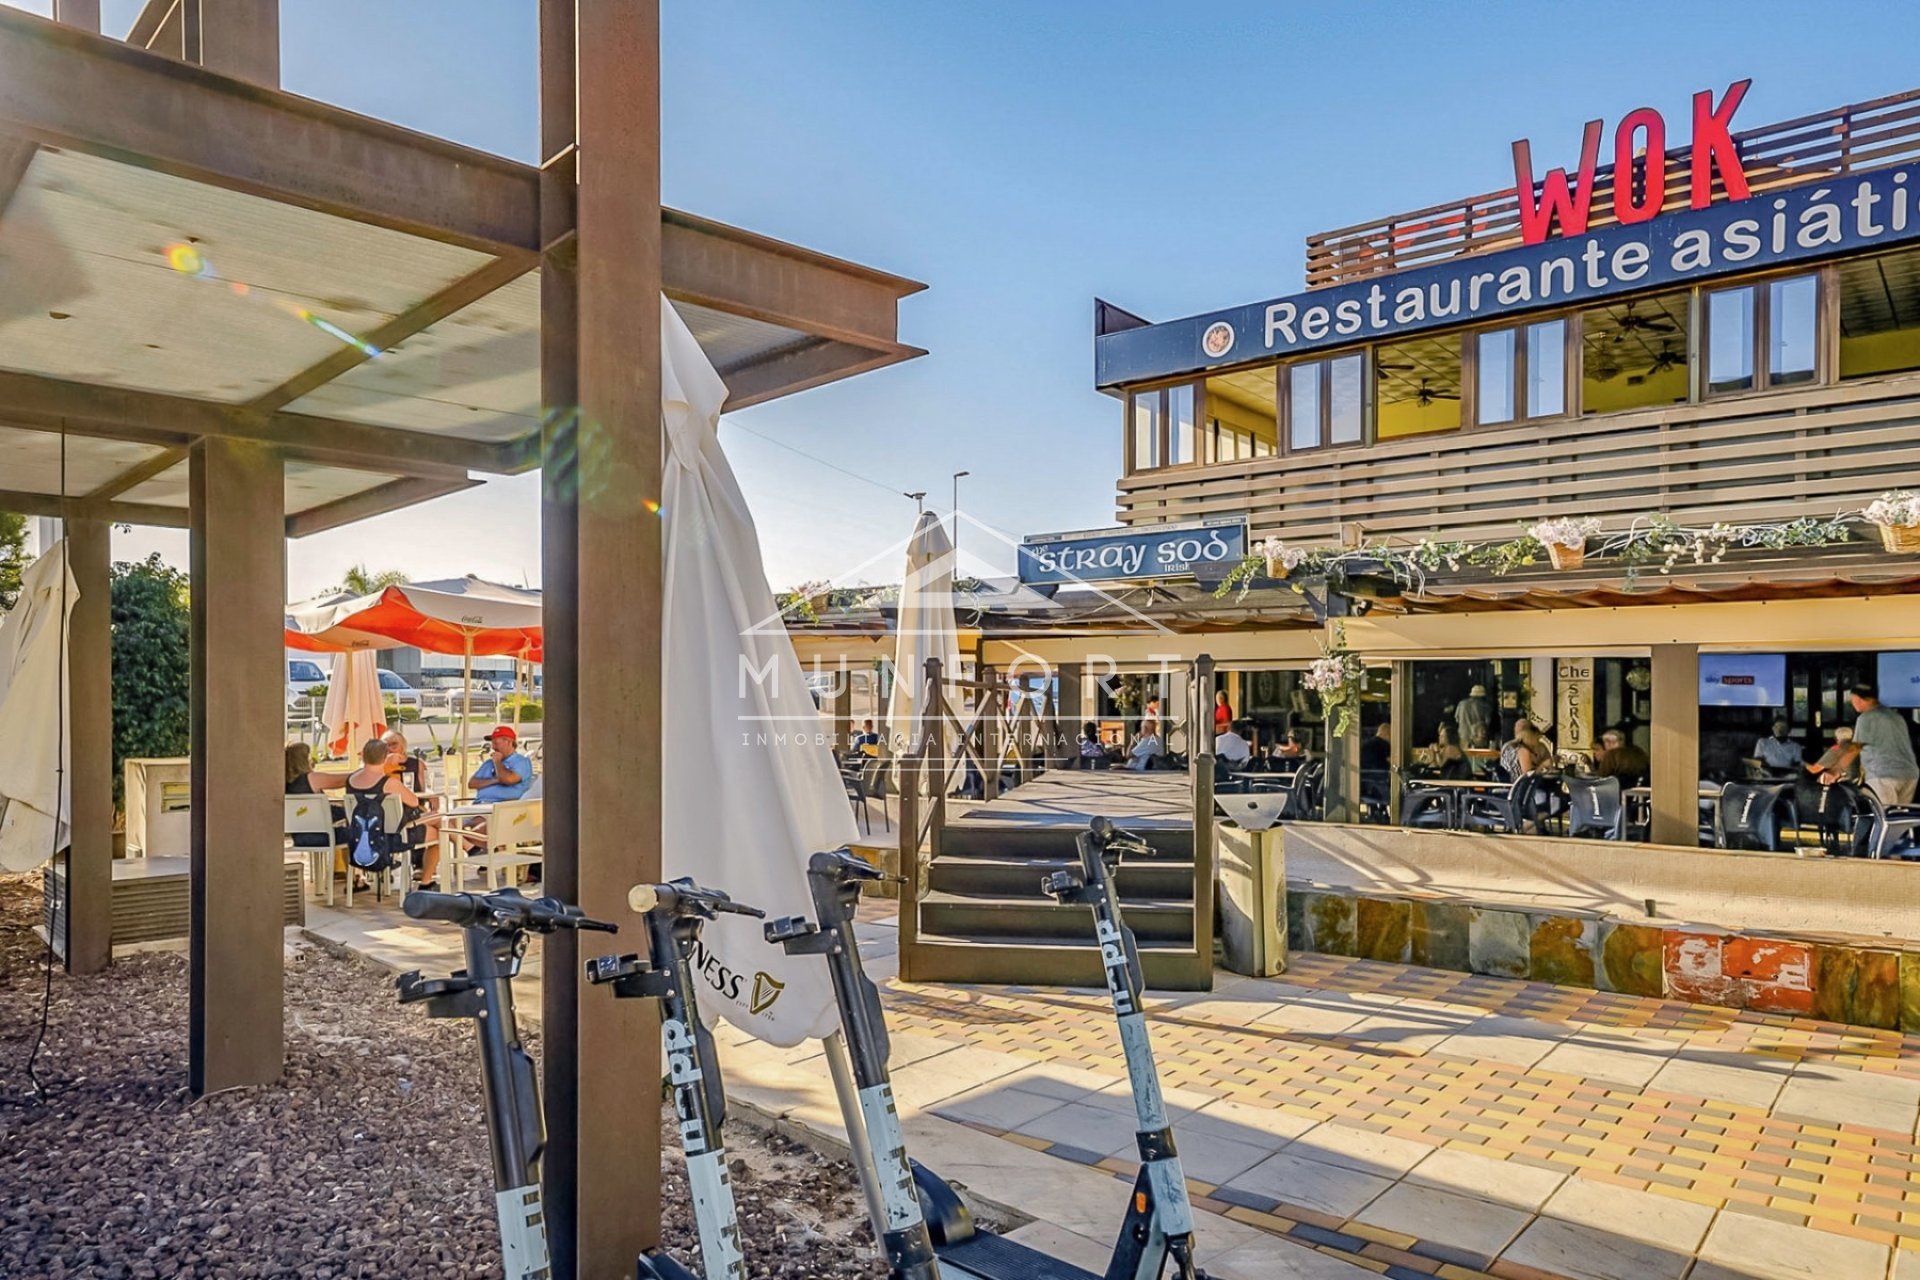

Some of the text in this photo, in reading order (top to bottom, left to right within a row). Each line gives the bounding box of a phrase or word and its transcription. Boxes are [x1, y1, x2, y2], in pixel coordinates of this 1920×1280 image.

[1511, 78, 1753, 247] WOK
[1263, 172, 1920, 348] Restaurante asiáti
